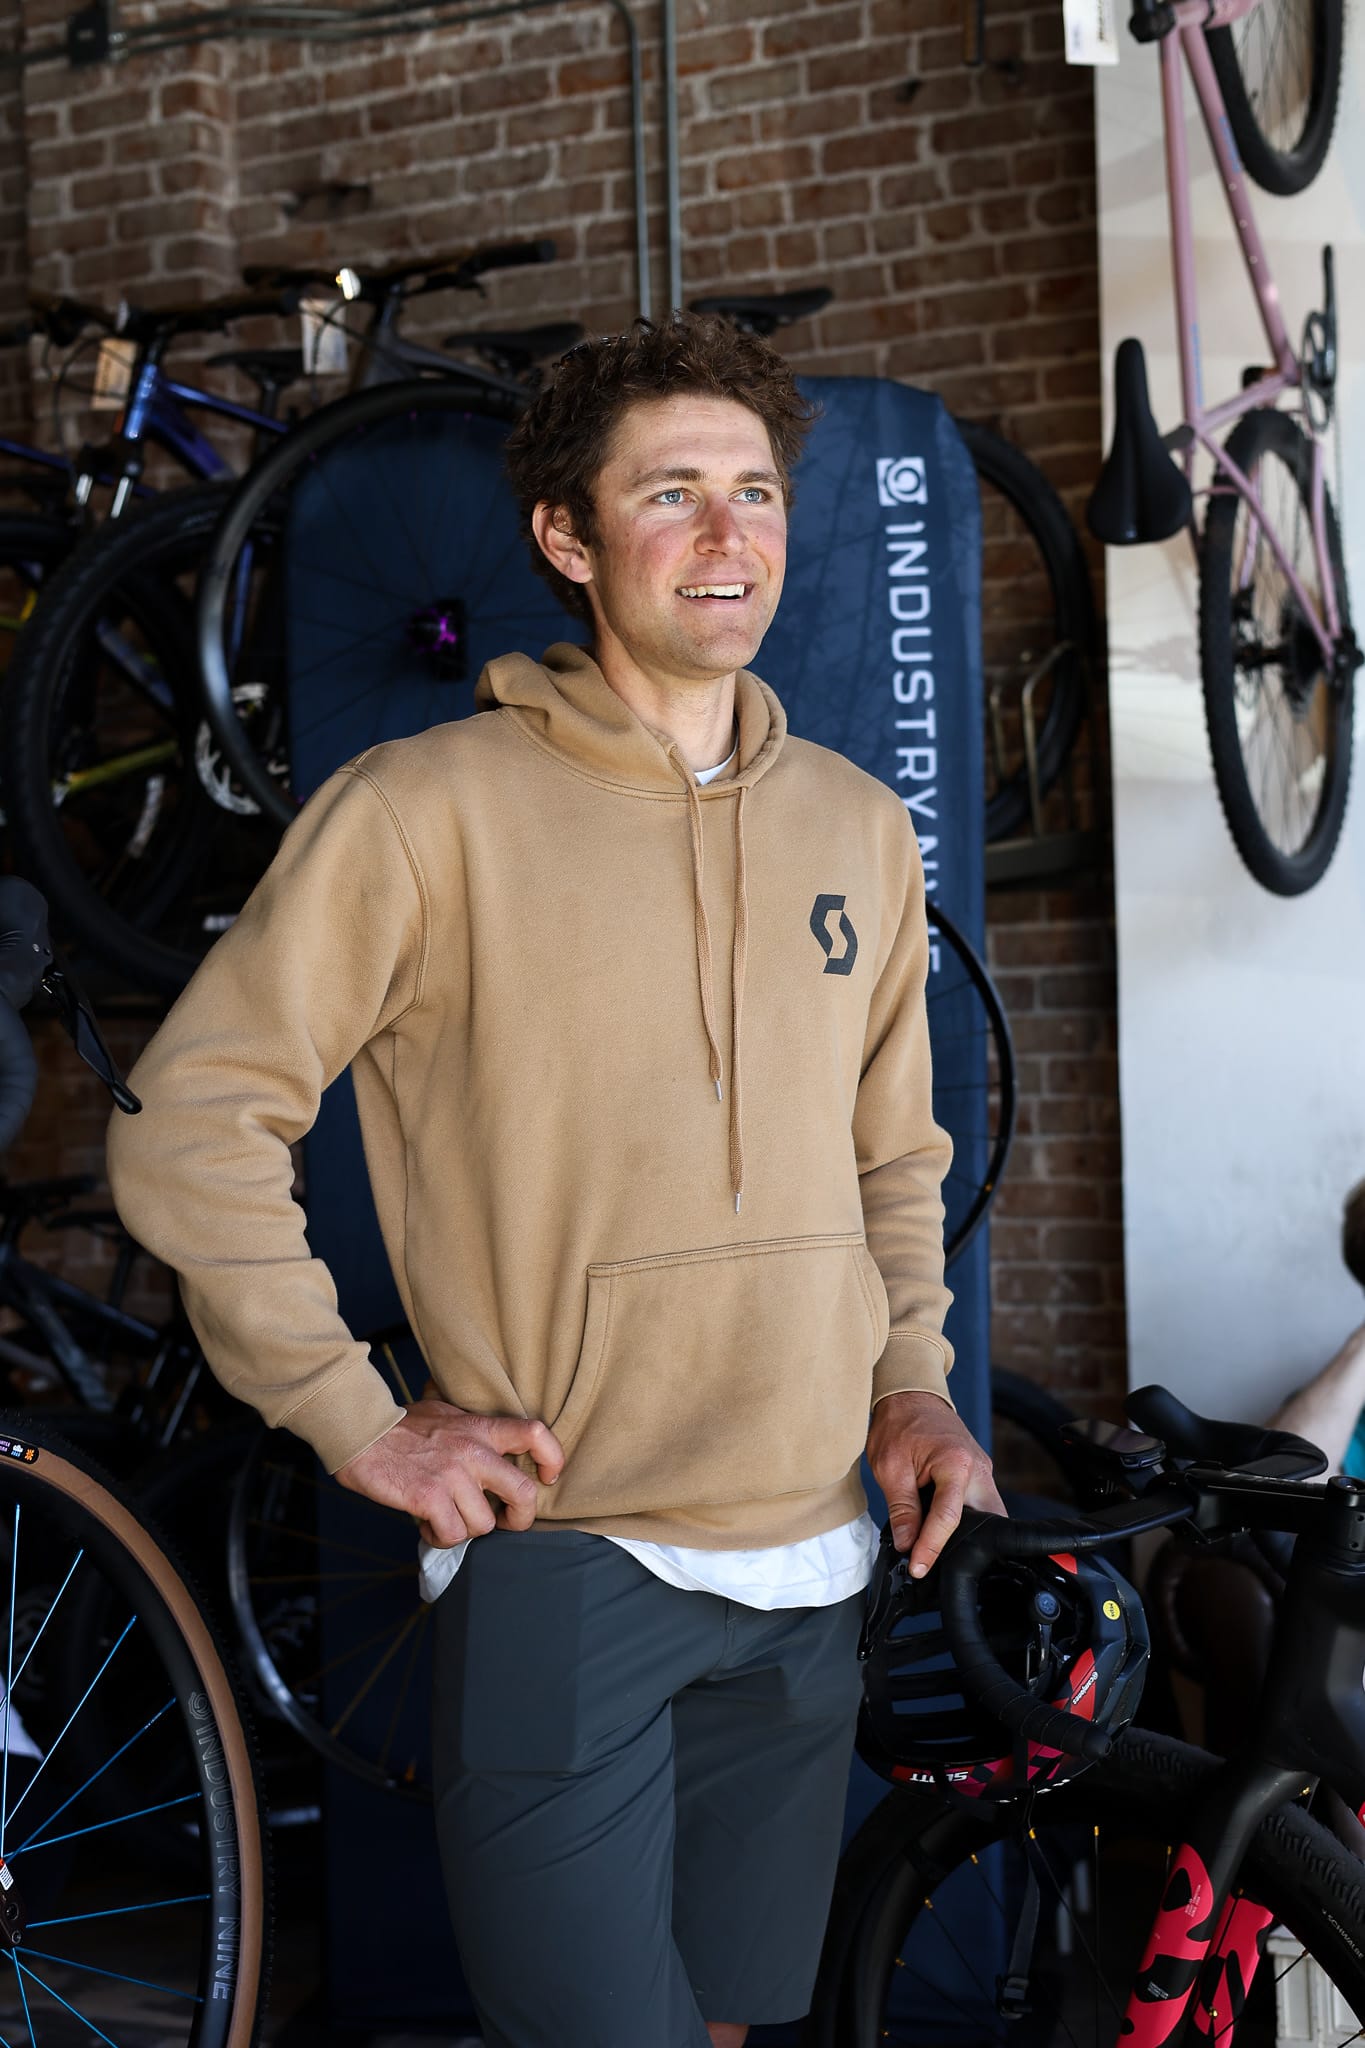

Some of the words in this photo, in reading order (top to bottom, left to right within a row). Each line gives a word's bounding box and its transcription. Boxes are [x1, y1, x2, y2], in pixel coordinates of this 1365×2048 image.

[885, 520, 938, 819] INDUSTRY
[195, 1721, 241, 1898] INDUSTRY
[212, 1916, 241, 2000] NINE
